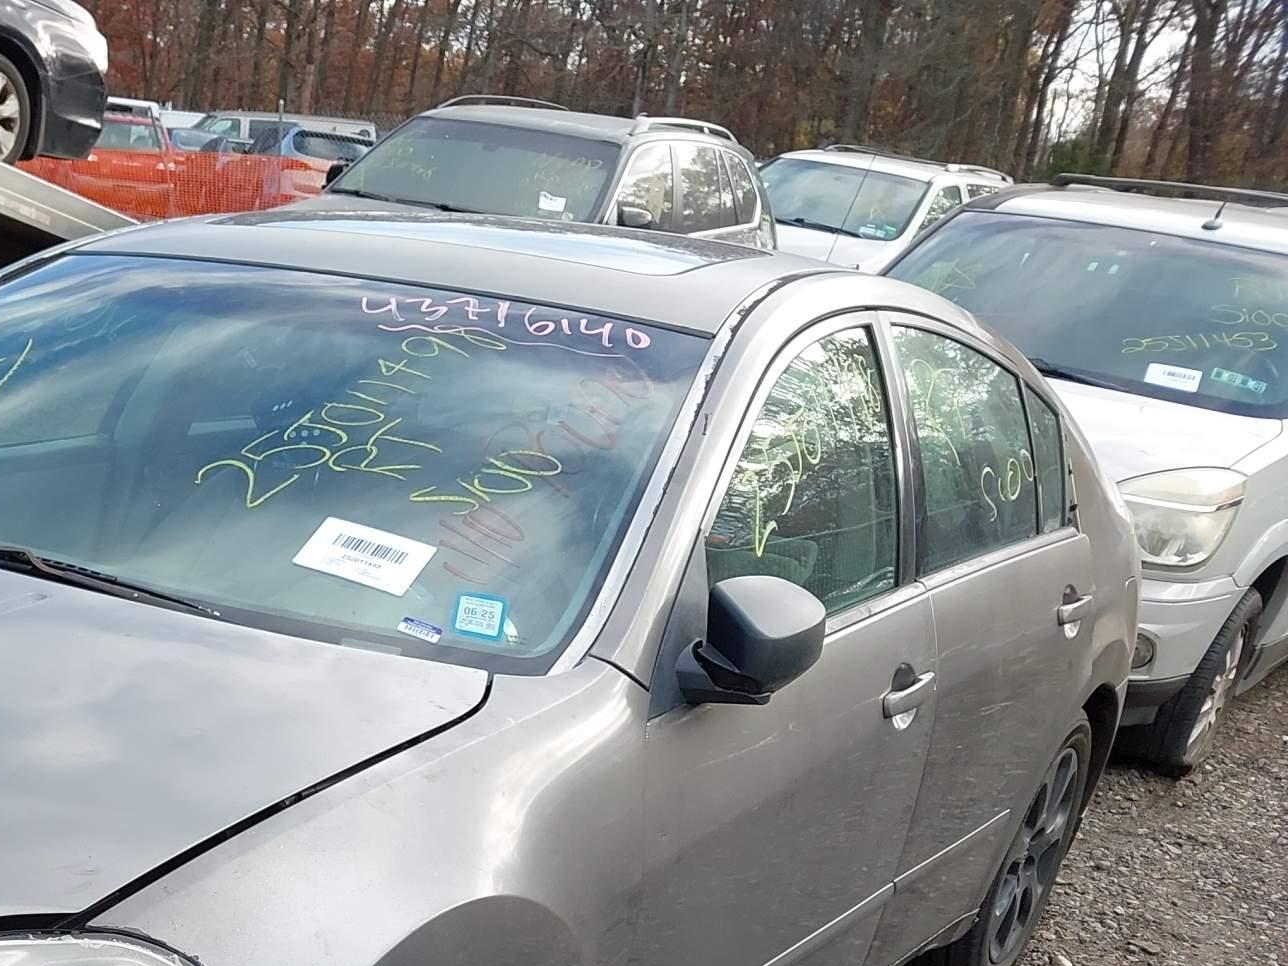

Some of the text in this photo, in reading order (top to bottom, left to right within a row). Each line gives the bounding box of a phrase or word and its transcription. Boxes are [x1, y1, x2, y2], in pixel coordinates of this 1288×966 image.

[361, 296, 651, 349] 43716140
[464, 606, 495, 620] 06 25
